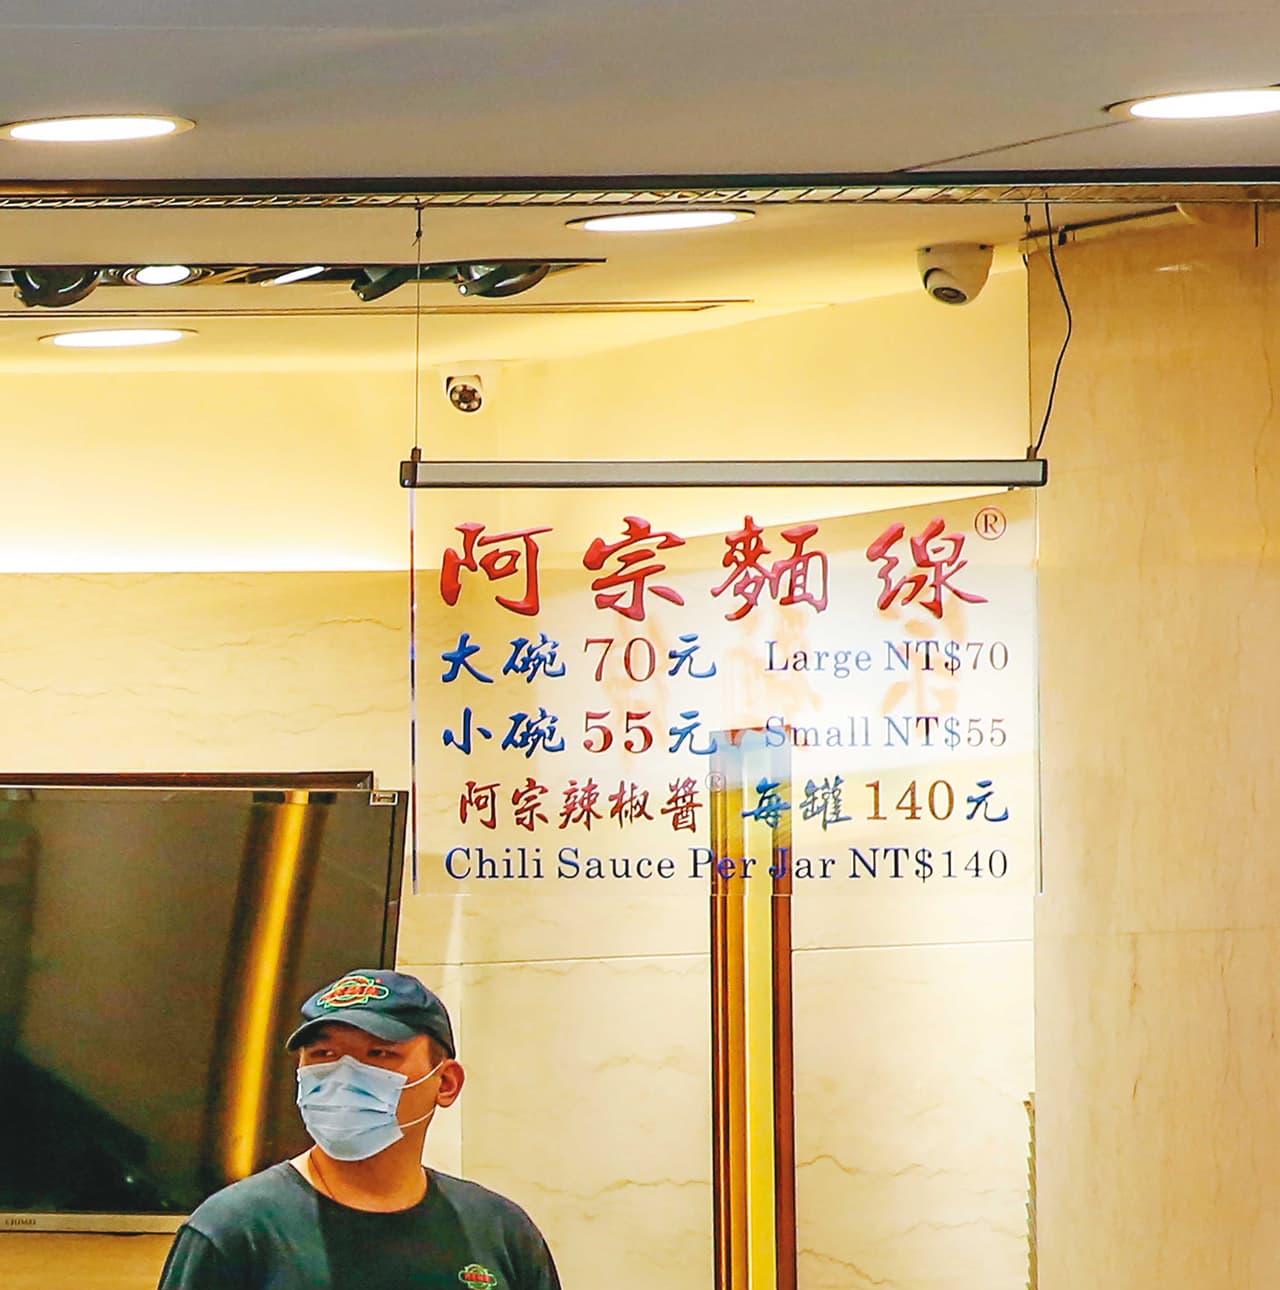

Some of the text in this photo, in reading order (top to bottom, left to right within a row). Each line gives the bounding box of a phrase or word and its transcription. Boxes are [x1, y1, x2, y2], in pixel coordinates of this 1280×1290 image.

[440, 515, 989, 622] 阿宗麵線
[764, 640, 872, 679] Large
[883, 640, 1009, 676] NT$70
[765, 715, 872, 747] Small
[883, 715, 1007, 751] NT$55
[444, 847, 1008, 884] Chili Sauce Per Jar NT$140
